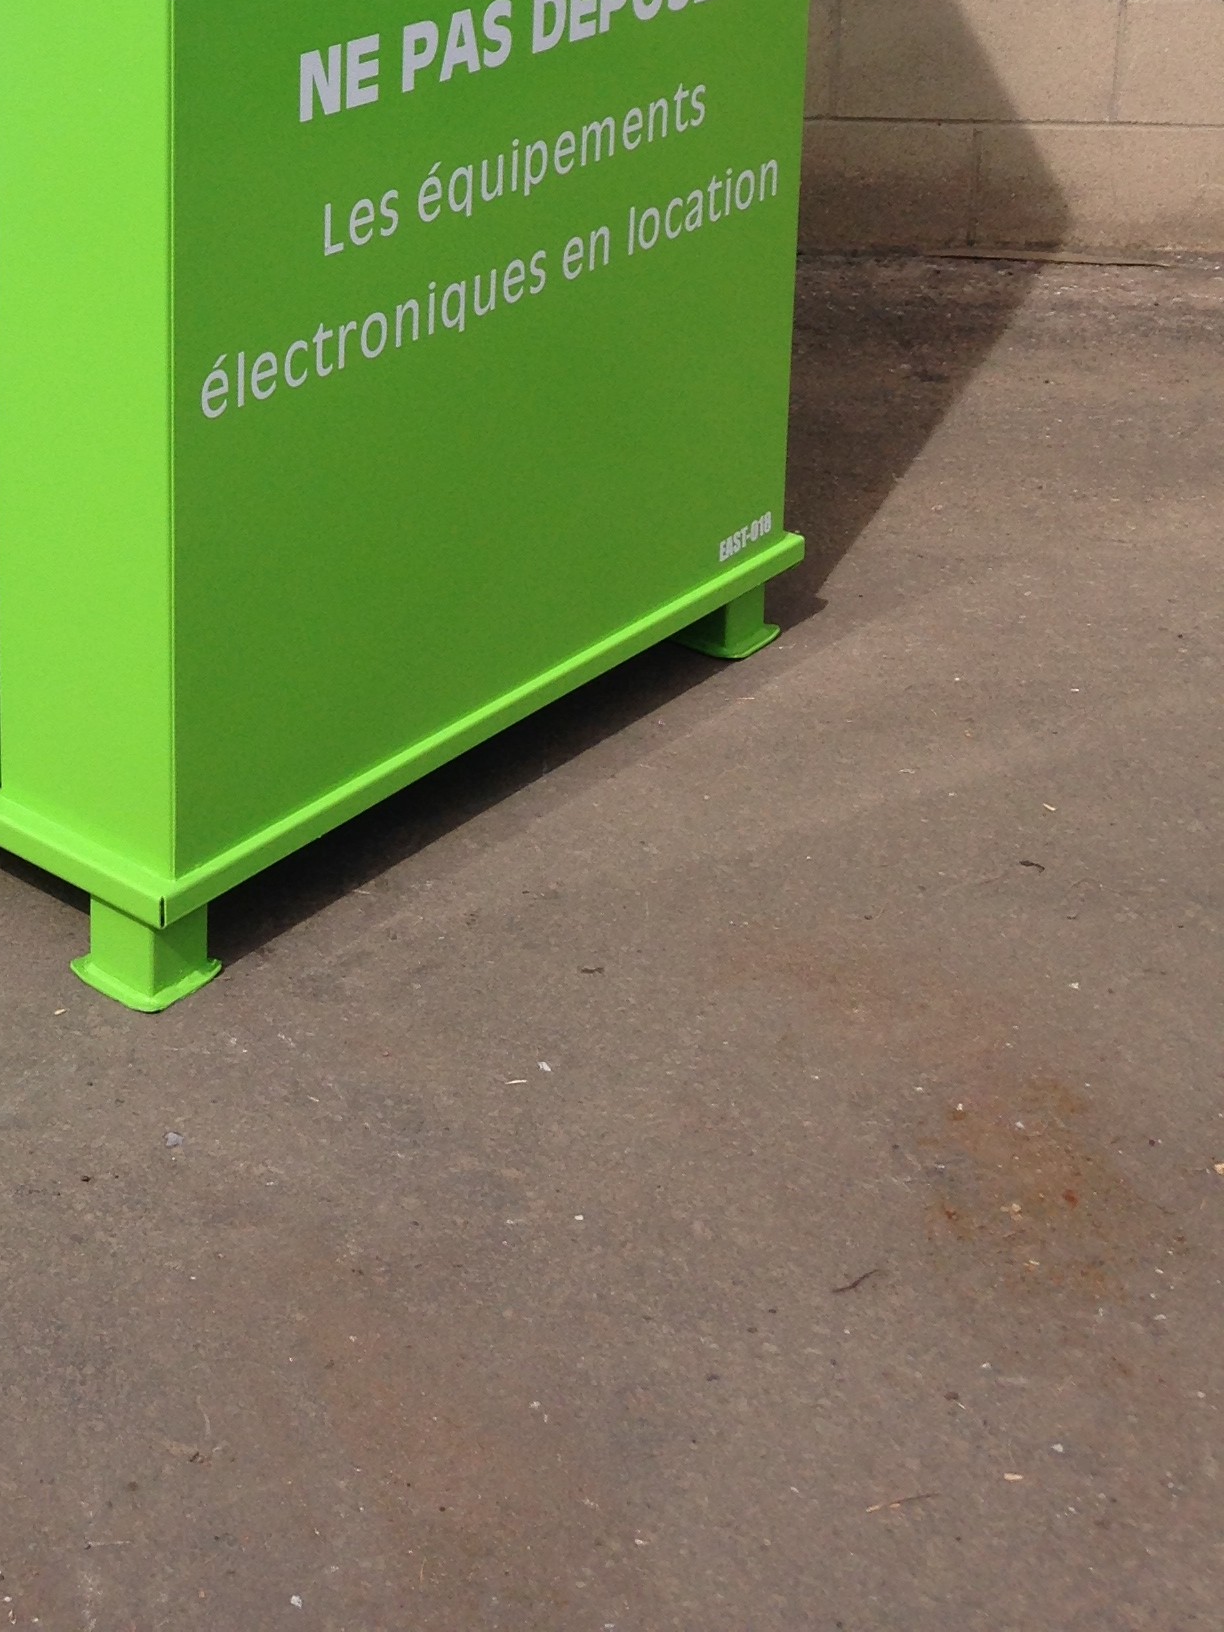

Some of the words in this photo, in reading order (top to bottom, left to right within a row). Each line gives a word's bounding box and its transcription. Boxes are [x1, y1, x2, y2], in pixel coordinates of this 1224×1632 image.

[299, 33, 381, 123] NE
[324, 188, 398, 257] Les
[418, 81, 706, 222] équipements
[200, 248, 546, 418] électroniques
[563, 224, 609, 280] en
[627, 158, 778, 256] location
